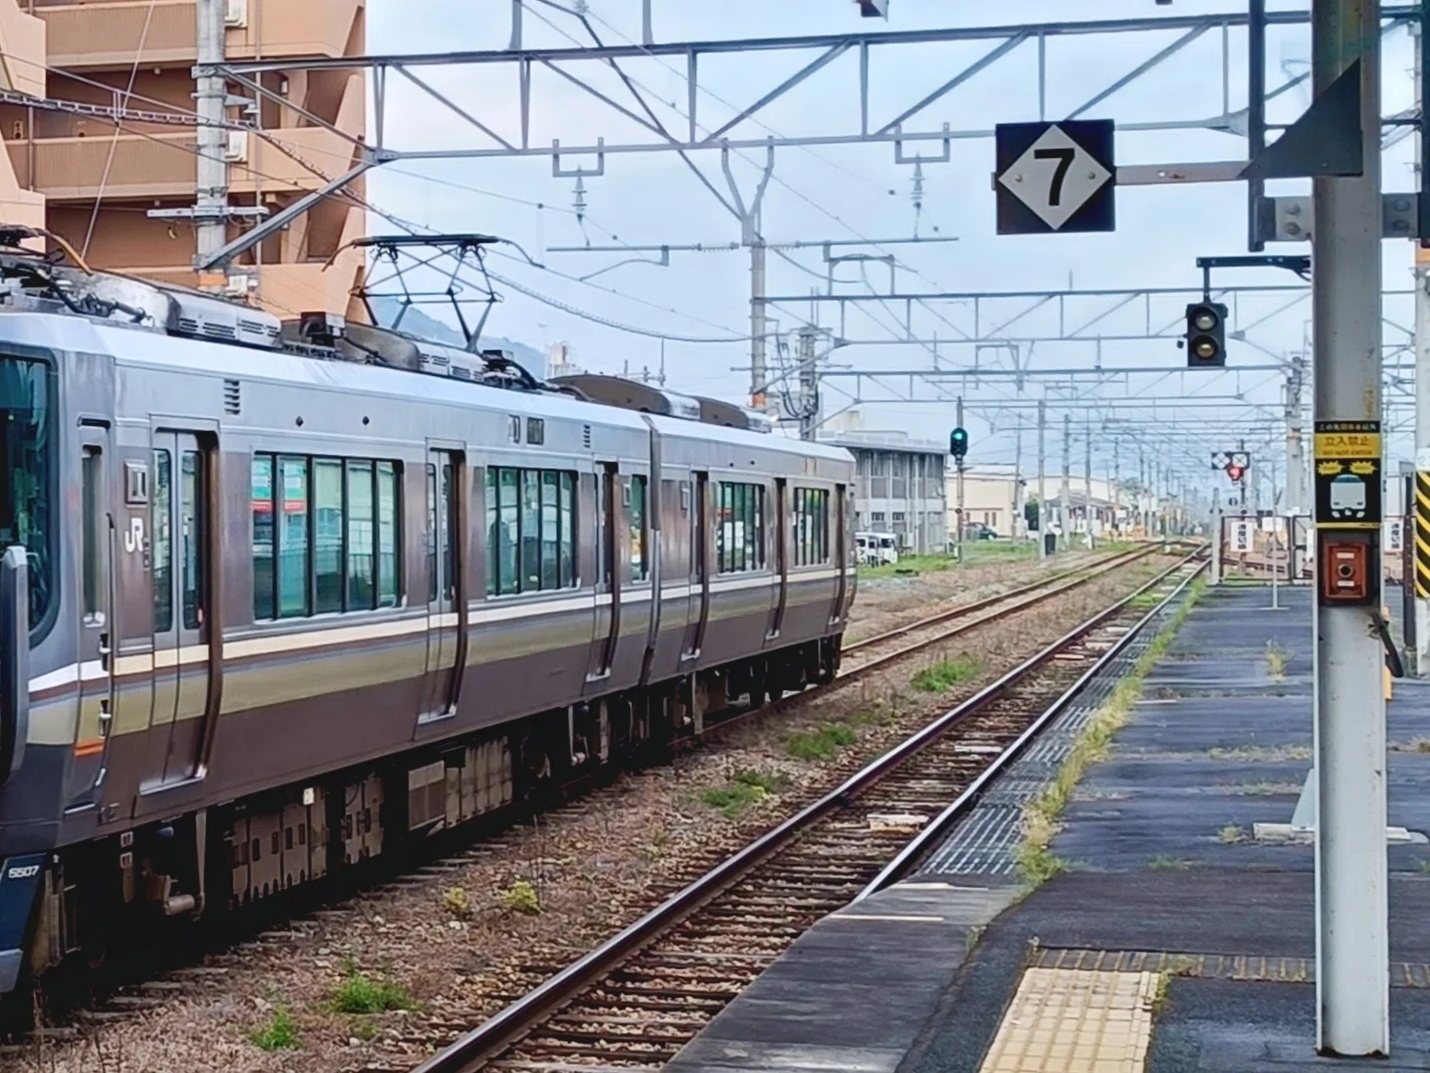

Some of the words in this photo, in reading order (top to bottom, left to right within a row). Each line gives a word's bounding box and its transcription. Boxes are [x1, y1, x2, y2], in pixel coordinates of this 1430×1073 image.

[1034, 148, 1075, 206] 7
[1324, 435, 1370, 446] 立入禁止
[125, 517, 144, 553] JR
